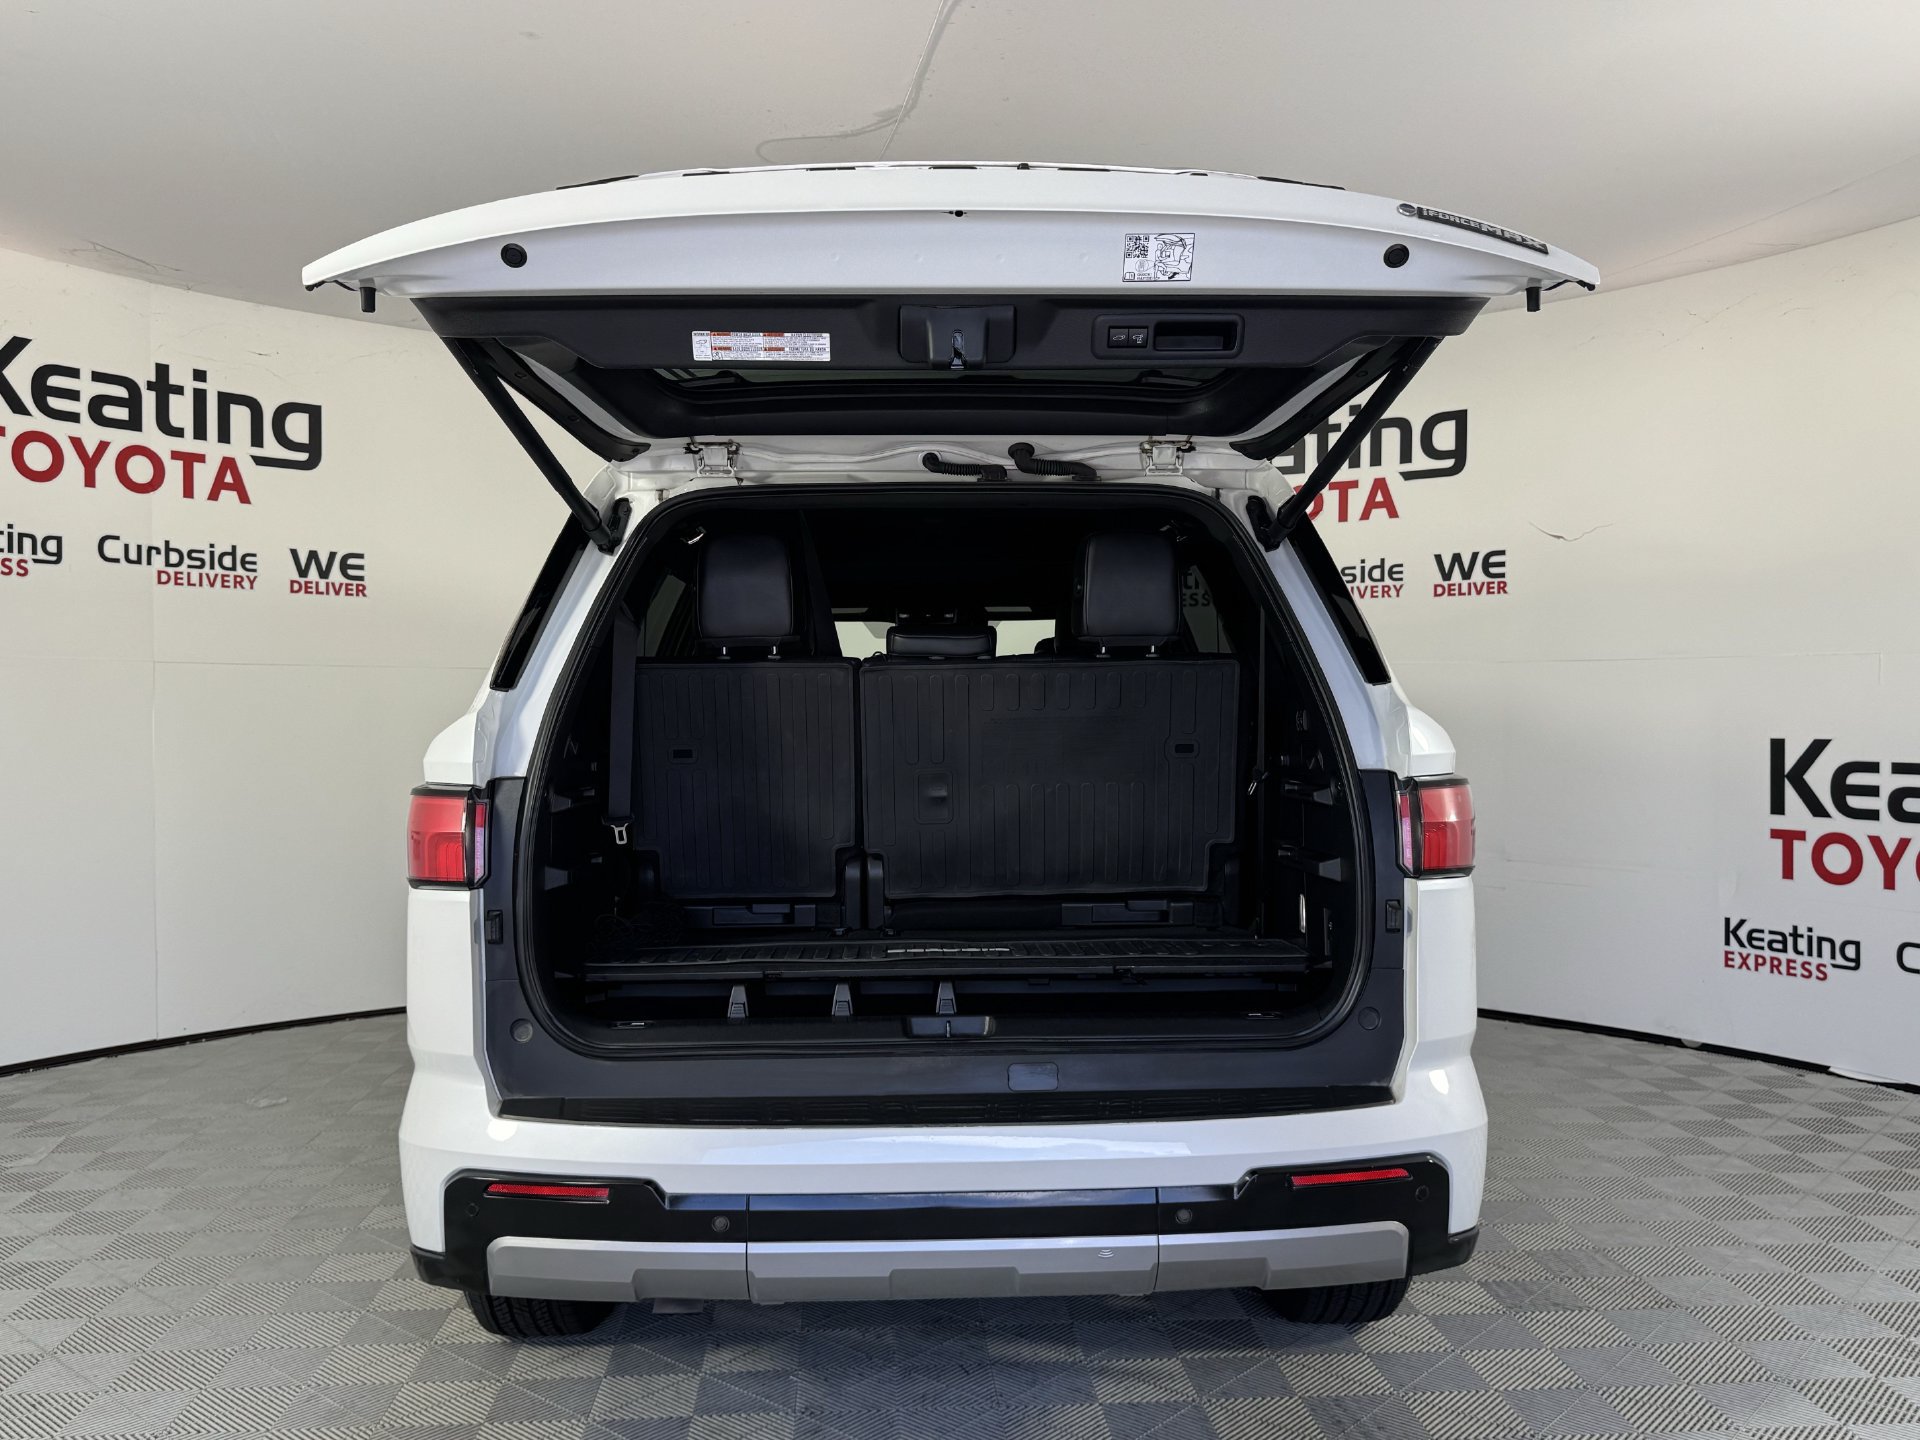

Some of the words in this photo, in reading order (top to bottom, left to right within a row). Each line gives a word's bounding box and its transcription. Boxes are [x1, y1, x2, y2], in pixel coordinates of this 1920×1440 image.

[0, 426, 252, 505] OYOTA
[97, 534, 258, 573] Curbside
[289, 548, 366, 581] WE
[1433, 549, 1507, 582] WE
[156, 570, 258, 590] DELIVERY
[289, 579, 367, 598] DELIVER
[1433, 580, 1509, 598] DELIVER
[1770, 828, 1920, 891] TOY
[1724, 916, 1861, 971] Keating
[1724, 950, 1829, 982] EXPRESS
